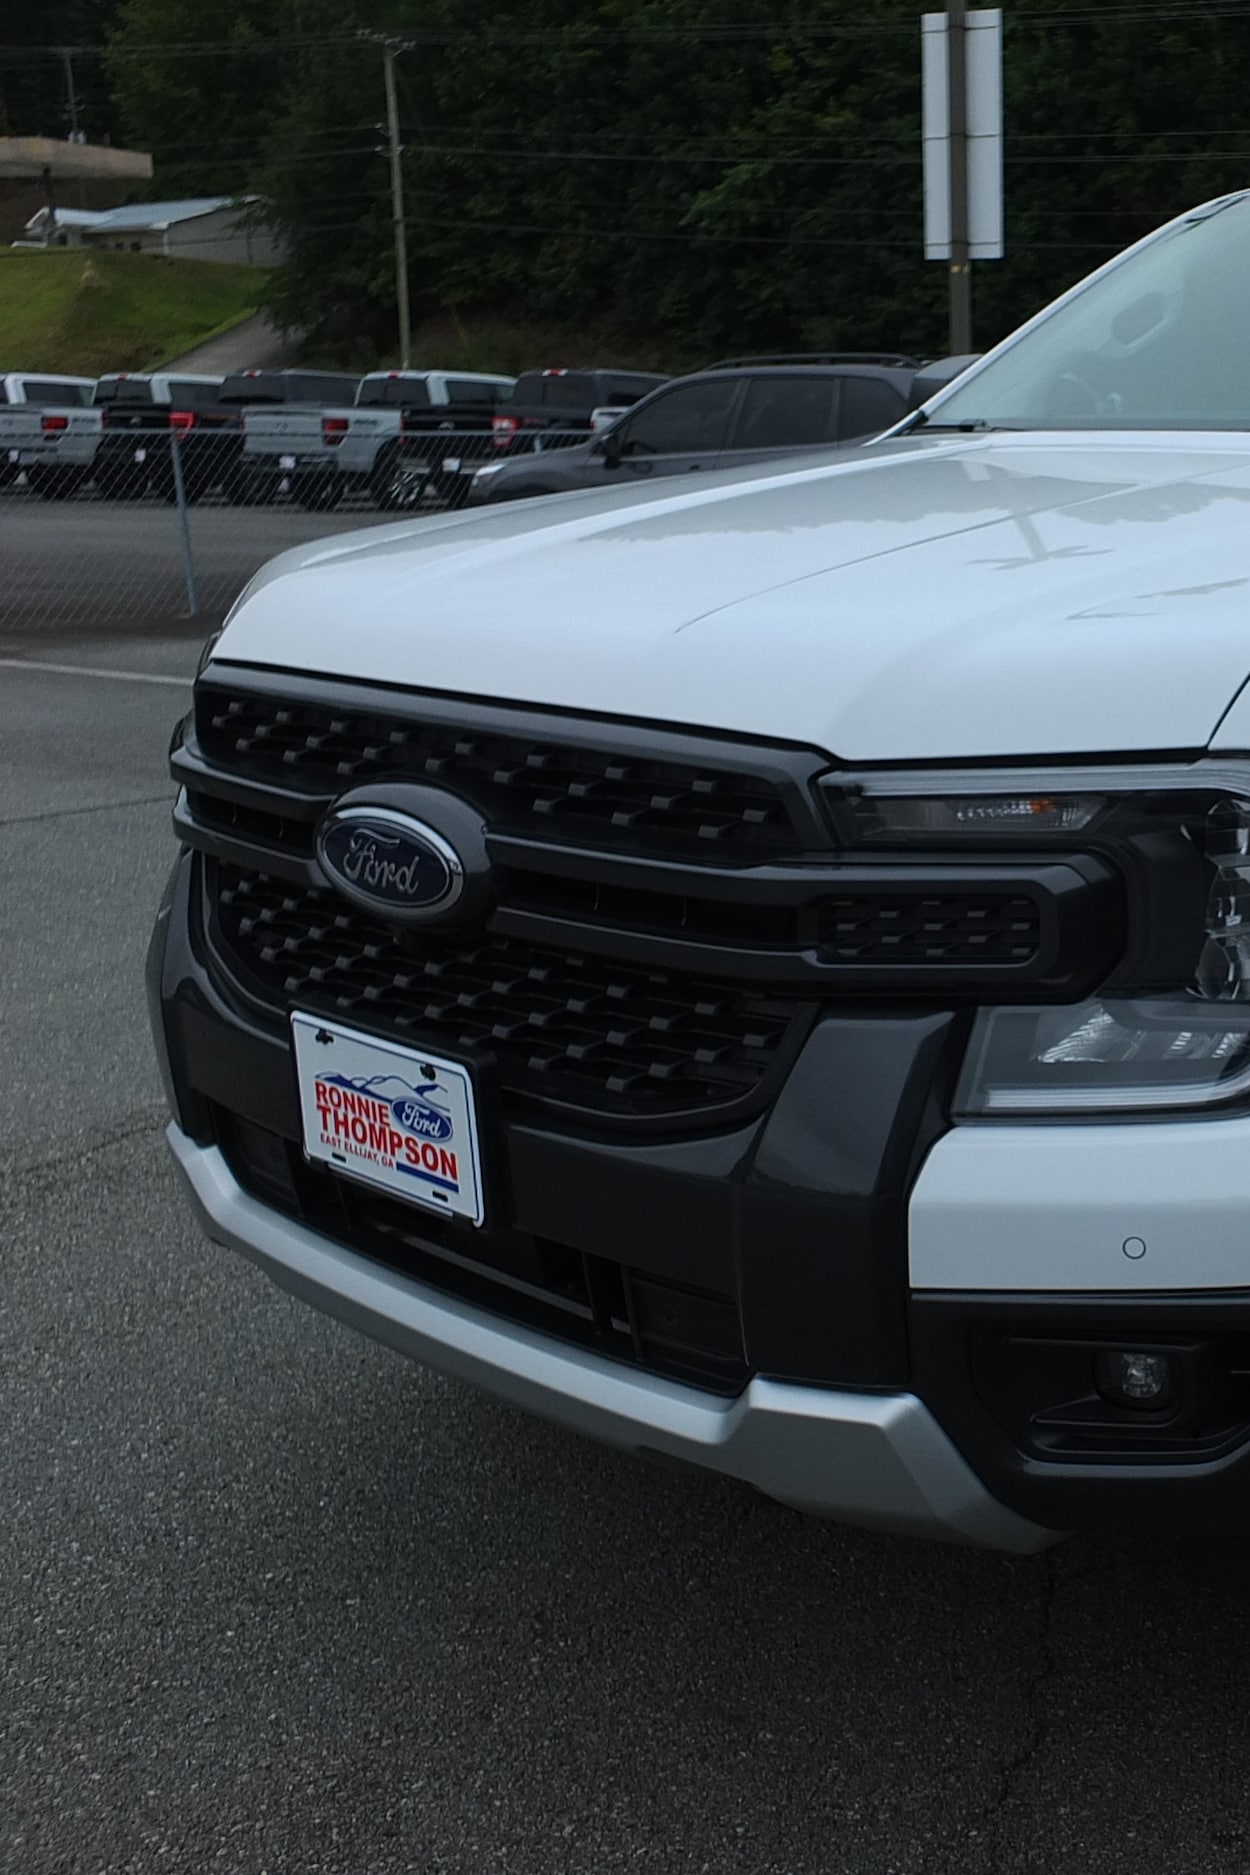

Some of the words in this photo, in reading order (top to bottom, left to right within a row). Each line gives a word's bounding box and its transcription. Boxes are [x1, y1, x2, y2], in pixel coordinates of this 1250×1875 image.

[344, 828, 419, 894] Ford
[315, 1081, 390, 1127] RONNIE
[403, 1102, 443, 1138] Ford
[317, 1104, 459, 1182] THOMPSON
[320, 1133, 342, 1149] EAST
[381, 1155, 395, 1169] GA
